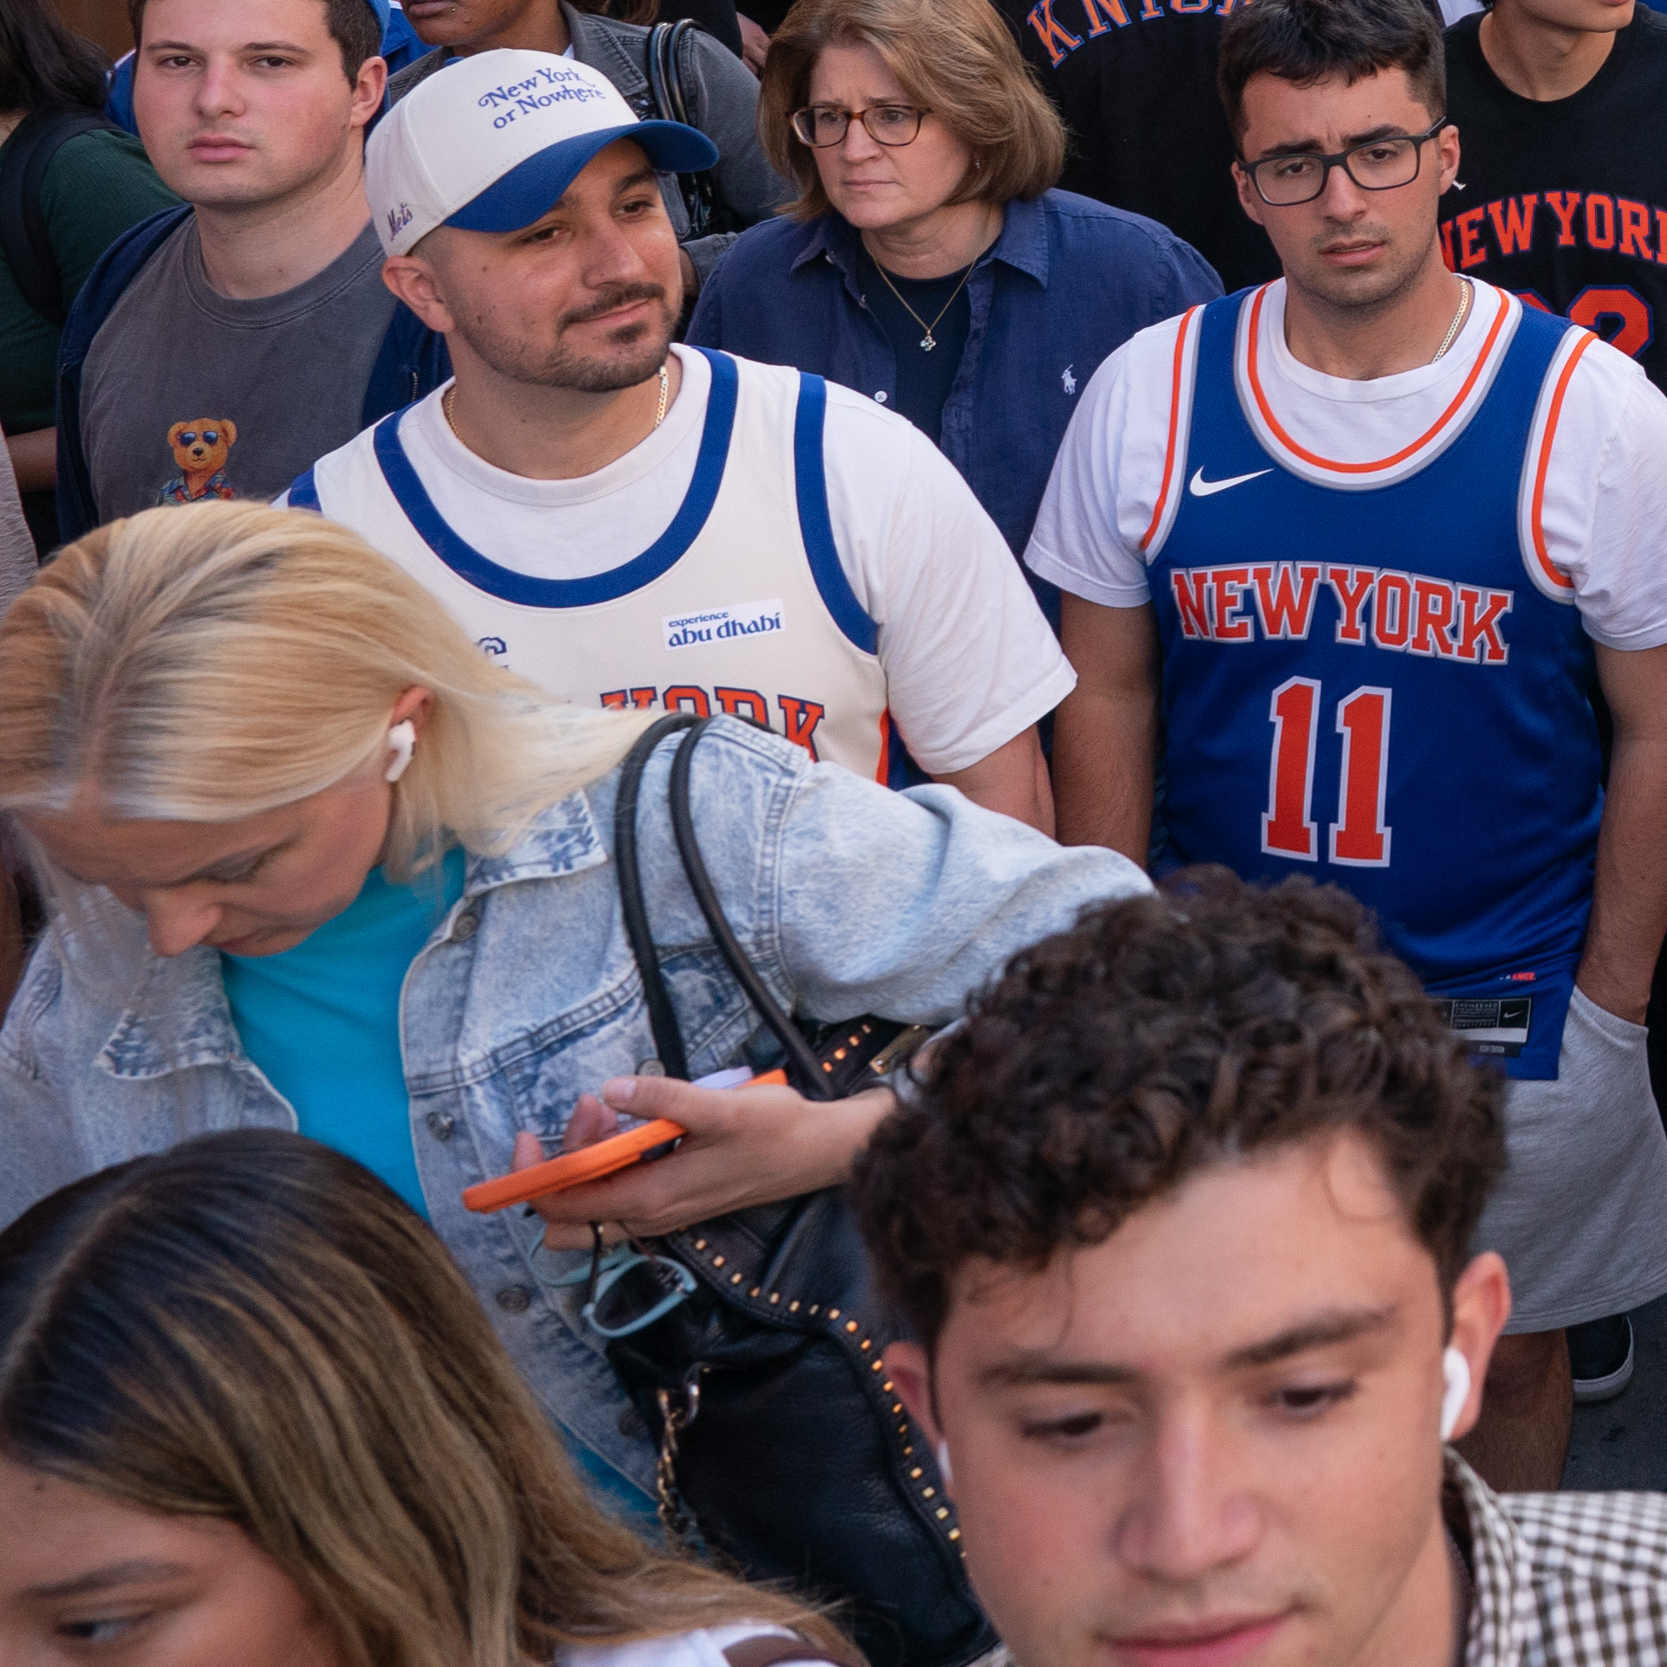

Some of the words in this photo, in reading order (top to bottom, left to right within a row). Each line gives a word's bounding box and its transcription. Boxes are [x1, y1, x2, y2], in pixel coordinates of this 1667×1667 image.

[477, 82, 531, 111] New
[535, 65, 598, 93] York
[491, 107, 518, 131] or
[516, 84, 608, 120] Nowhere
[667, 622, 713, 648] abu
[668, 610, 729, 628] experience
[1170, 560, 1320, 647] NEW
[1319, 560, 1515, 666] YORK
[1261, 677, 1393, 869] 11
